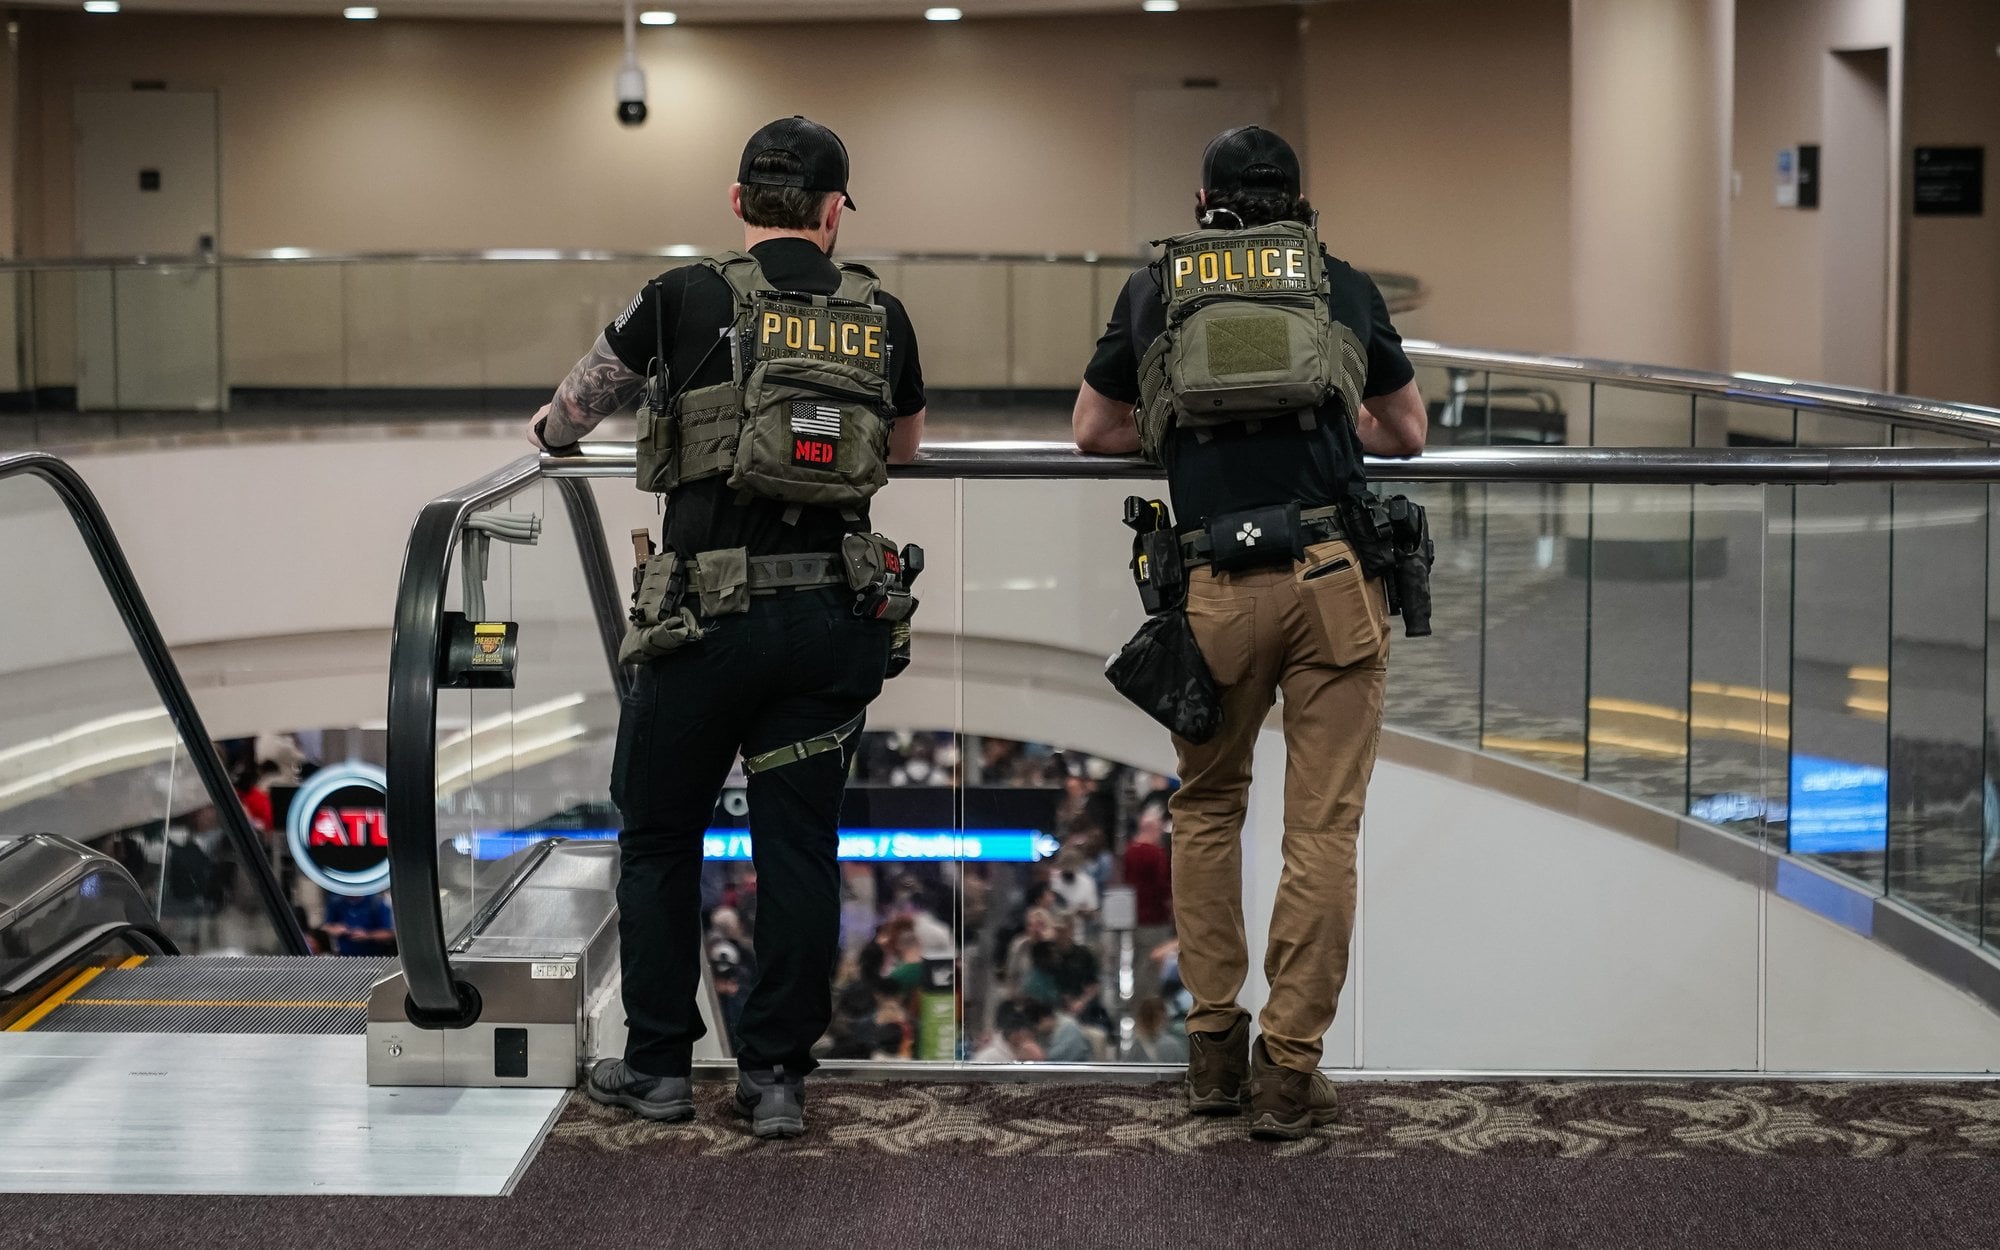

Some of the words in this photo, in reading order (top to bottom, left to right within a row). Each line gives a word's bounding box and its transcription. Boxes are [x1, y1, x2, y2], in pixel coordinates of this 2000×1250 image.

[1211, 240, 1247, 249] SECURITY
[1248, 239, 1304, 248] INVESTIGATIONS
[1174, 247, 1306, 289] POLICE
[1248, 279, 1274, 291] TASK
[1276, 279, 1307, 289] FORCE
[762, 311, 882, 359] POLICE
[853, 359, 881, 373] FORCE
[795, 439, 833, 464] MED
[475, 636, 505, 645] EMERGENCY
